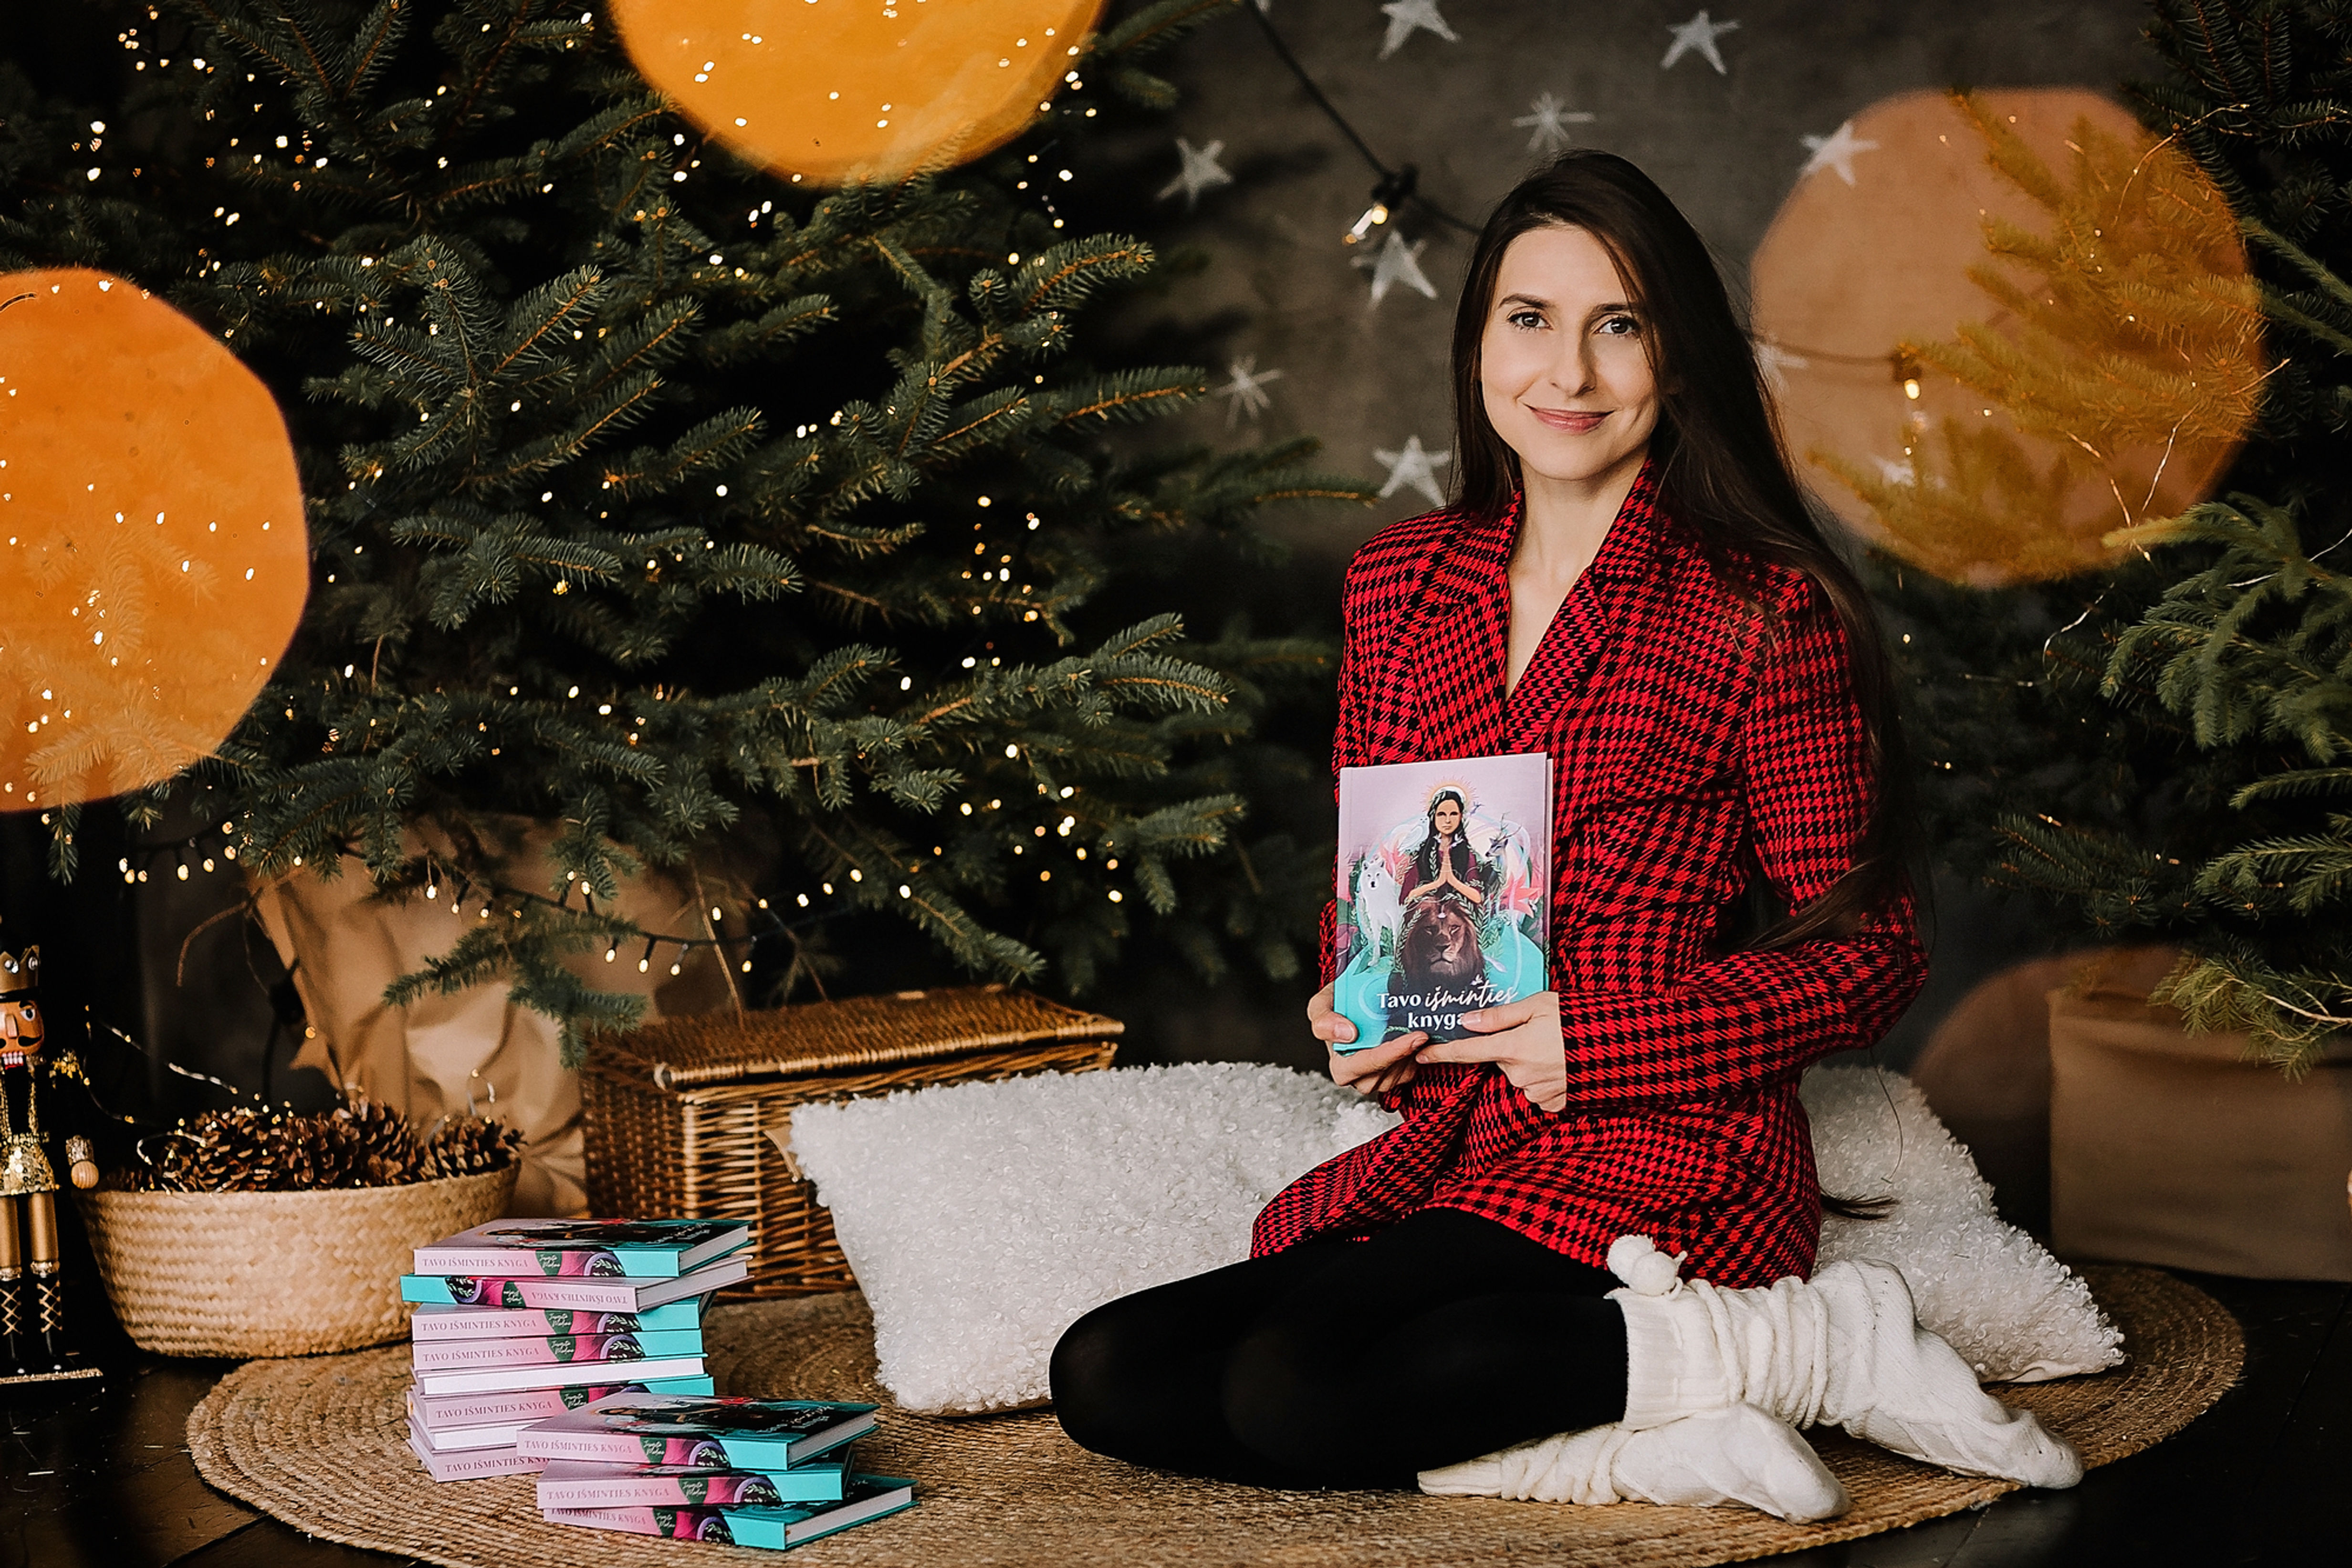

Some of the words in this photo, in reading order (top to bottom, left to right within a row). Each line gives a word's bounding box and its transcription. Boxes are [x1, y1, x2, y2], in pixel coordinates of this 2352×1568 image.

[1377, 993, 1421, 1009] Tavo
[1424, 980, 1518, 1011] išminties
[423, 1258, 446, 1267] TAVO
[449, 1255, 496, 1267] IŠMINTIES
[498, 1259, 529, 1267] KNYGA
[532, 1291, 559, 1301] KNYGA
[606, 1295, 628, 1304] TAVO
[421, 1323, 447, 1331] TAVO
[449, 1319, 501, 1330] IŠMINTIES
[504, 1320, 537, 1328] KNYGA
[423, 1353, 449, 1362] TAVO
[452, 1348, 502, 1360] IŠMINTIES
[505, 1348, 539, 1357] KNYGA
[436, 1410, 462, 1419] TAVO
[465, 1404, 516, 1416] IŠMINTIES
[519, 1401, 553, 1411] KNYGA
[525, 1440, 549, 1449] TAVO
[551, 1439, 599, 1452] IŠMINTIES
[601, 1444, 633, 1453] KNYGA
[445, 1463, 471, 1473] TAVO
[547, 1491, 575, 1500] TAVO
[577, 1487, 631, 1499] IŠMINTIES
[634, 1488, 669, 1497] KNYGA
